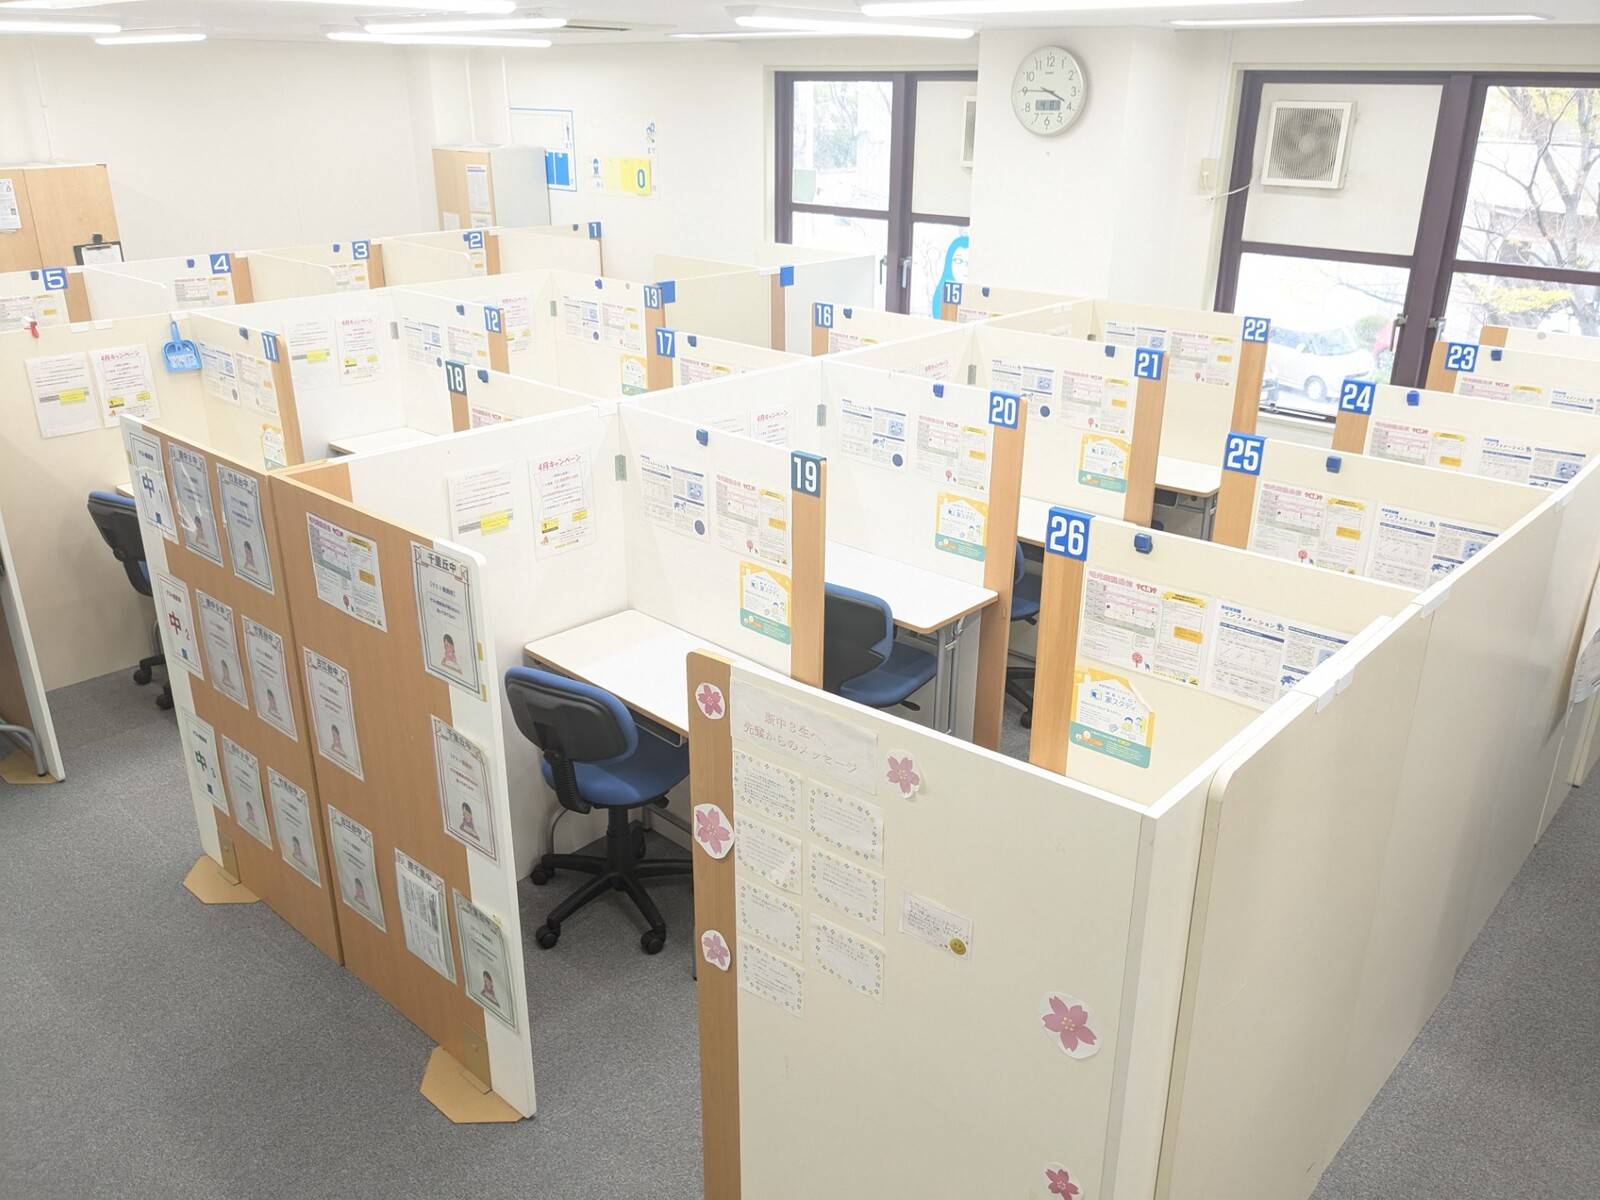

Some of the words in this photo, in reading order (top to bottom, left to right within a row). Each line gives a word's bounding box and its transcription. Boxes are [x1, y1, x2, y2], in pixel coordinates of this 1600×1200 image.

[1034, 57, 1042, 70] 11
[1046, 56, 1055, 67] 12
[1026, 71, 1035, 82] 10
[1068, 70, 1074, 81] 2
[1022, 86, 1028, 96] 9
[1070, 86, 1077, 97] 3
[1025, 103, 1031, 112] 8
[1066, 102, 1072, 111] 4
[1034, 112, 1039, 123] 7
[1044, 116, 1050, 127] 6
[1057, 112, 1063, 123] 5
[637, 169, 645, 188] 0
[470, 233, 481, 247] 2
[593, 224, 597, 237] 1
[354, 242, 368, 258] 3
[214, 255, 229, 271] 4
[45, 270, 65, 289] 5
[645, 287, 659, 309] 13
[945, 284, 960, 304] 15
[485, 308, 500, 332] 12
[816, 304, 831, 327] 16
[1244, 319, 1267, 342] 22
[263, 333, 277, 361] 11
[657, 332, 673, 356] 17
[1137, 353, 1158, 378] 21
[1447, 345, 1474, 371] 23
[446, 364, 464, 392] 18
[1342, 384, 1371, 412] 24
[991, 396, 1017, 425] 20
[538, 454, 582, 471] 4月キャンペーン
[1227, 438, 1261, 472] 25
[793, 458, 816, 492] 19
[1049, 516, 1084, 556] 26
[427, 553, 457, 573] 千里丘中
[1223, 611, 1275, 629] インフォメーション
